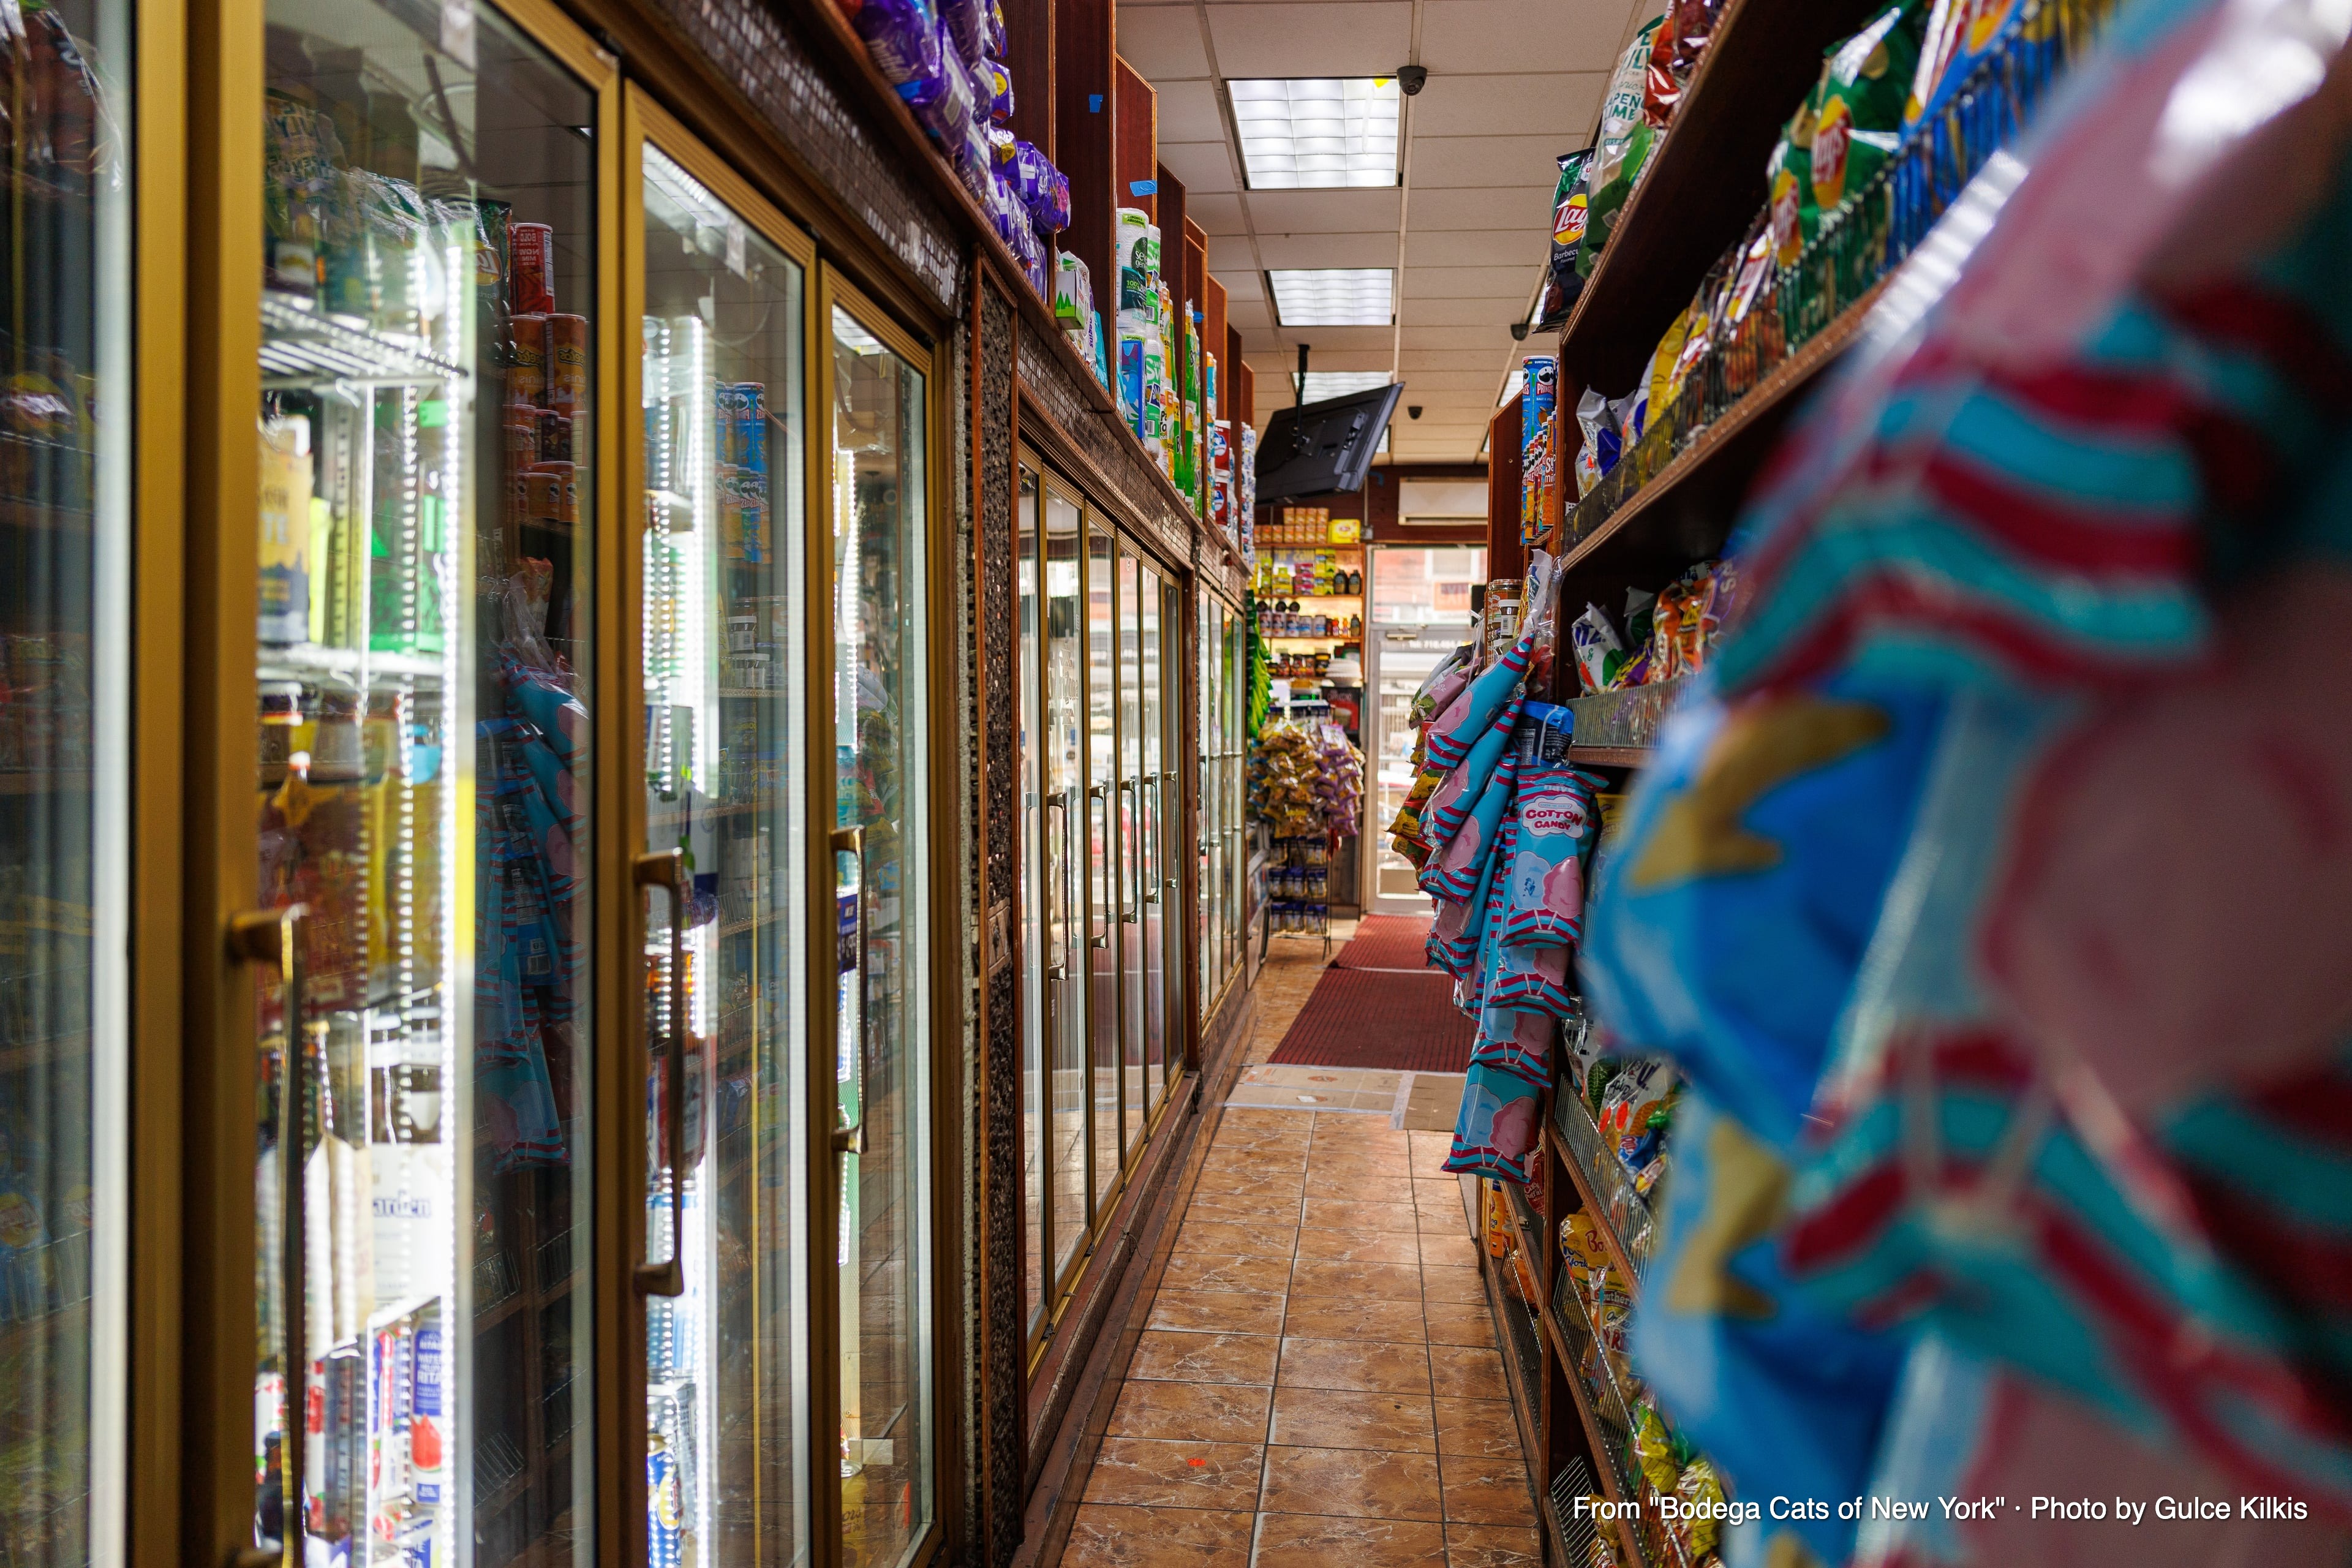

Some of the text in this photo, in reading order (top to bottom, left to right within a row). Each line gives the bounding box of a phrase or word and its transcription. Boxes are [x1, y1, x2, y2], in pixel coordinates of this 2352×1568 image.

[1555, 206, 1588, 233] Lay
[1537, 382, 1554, 396] PRINGLE
[1525, 809, 1583, 826] COTTON
[1534, 820, 1571, 831] CANDY
